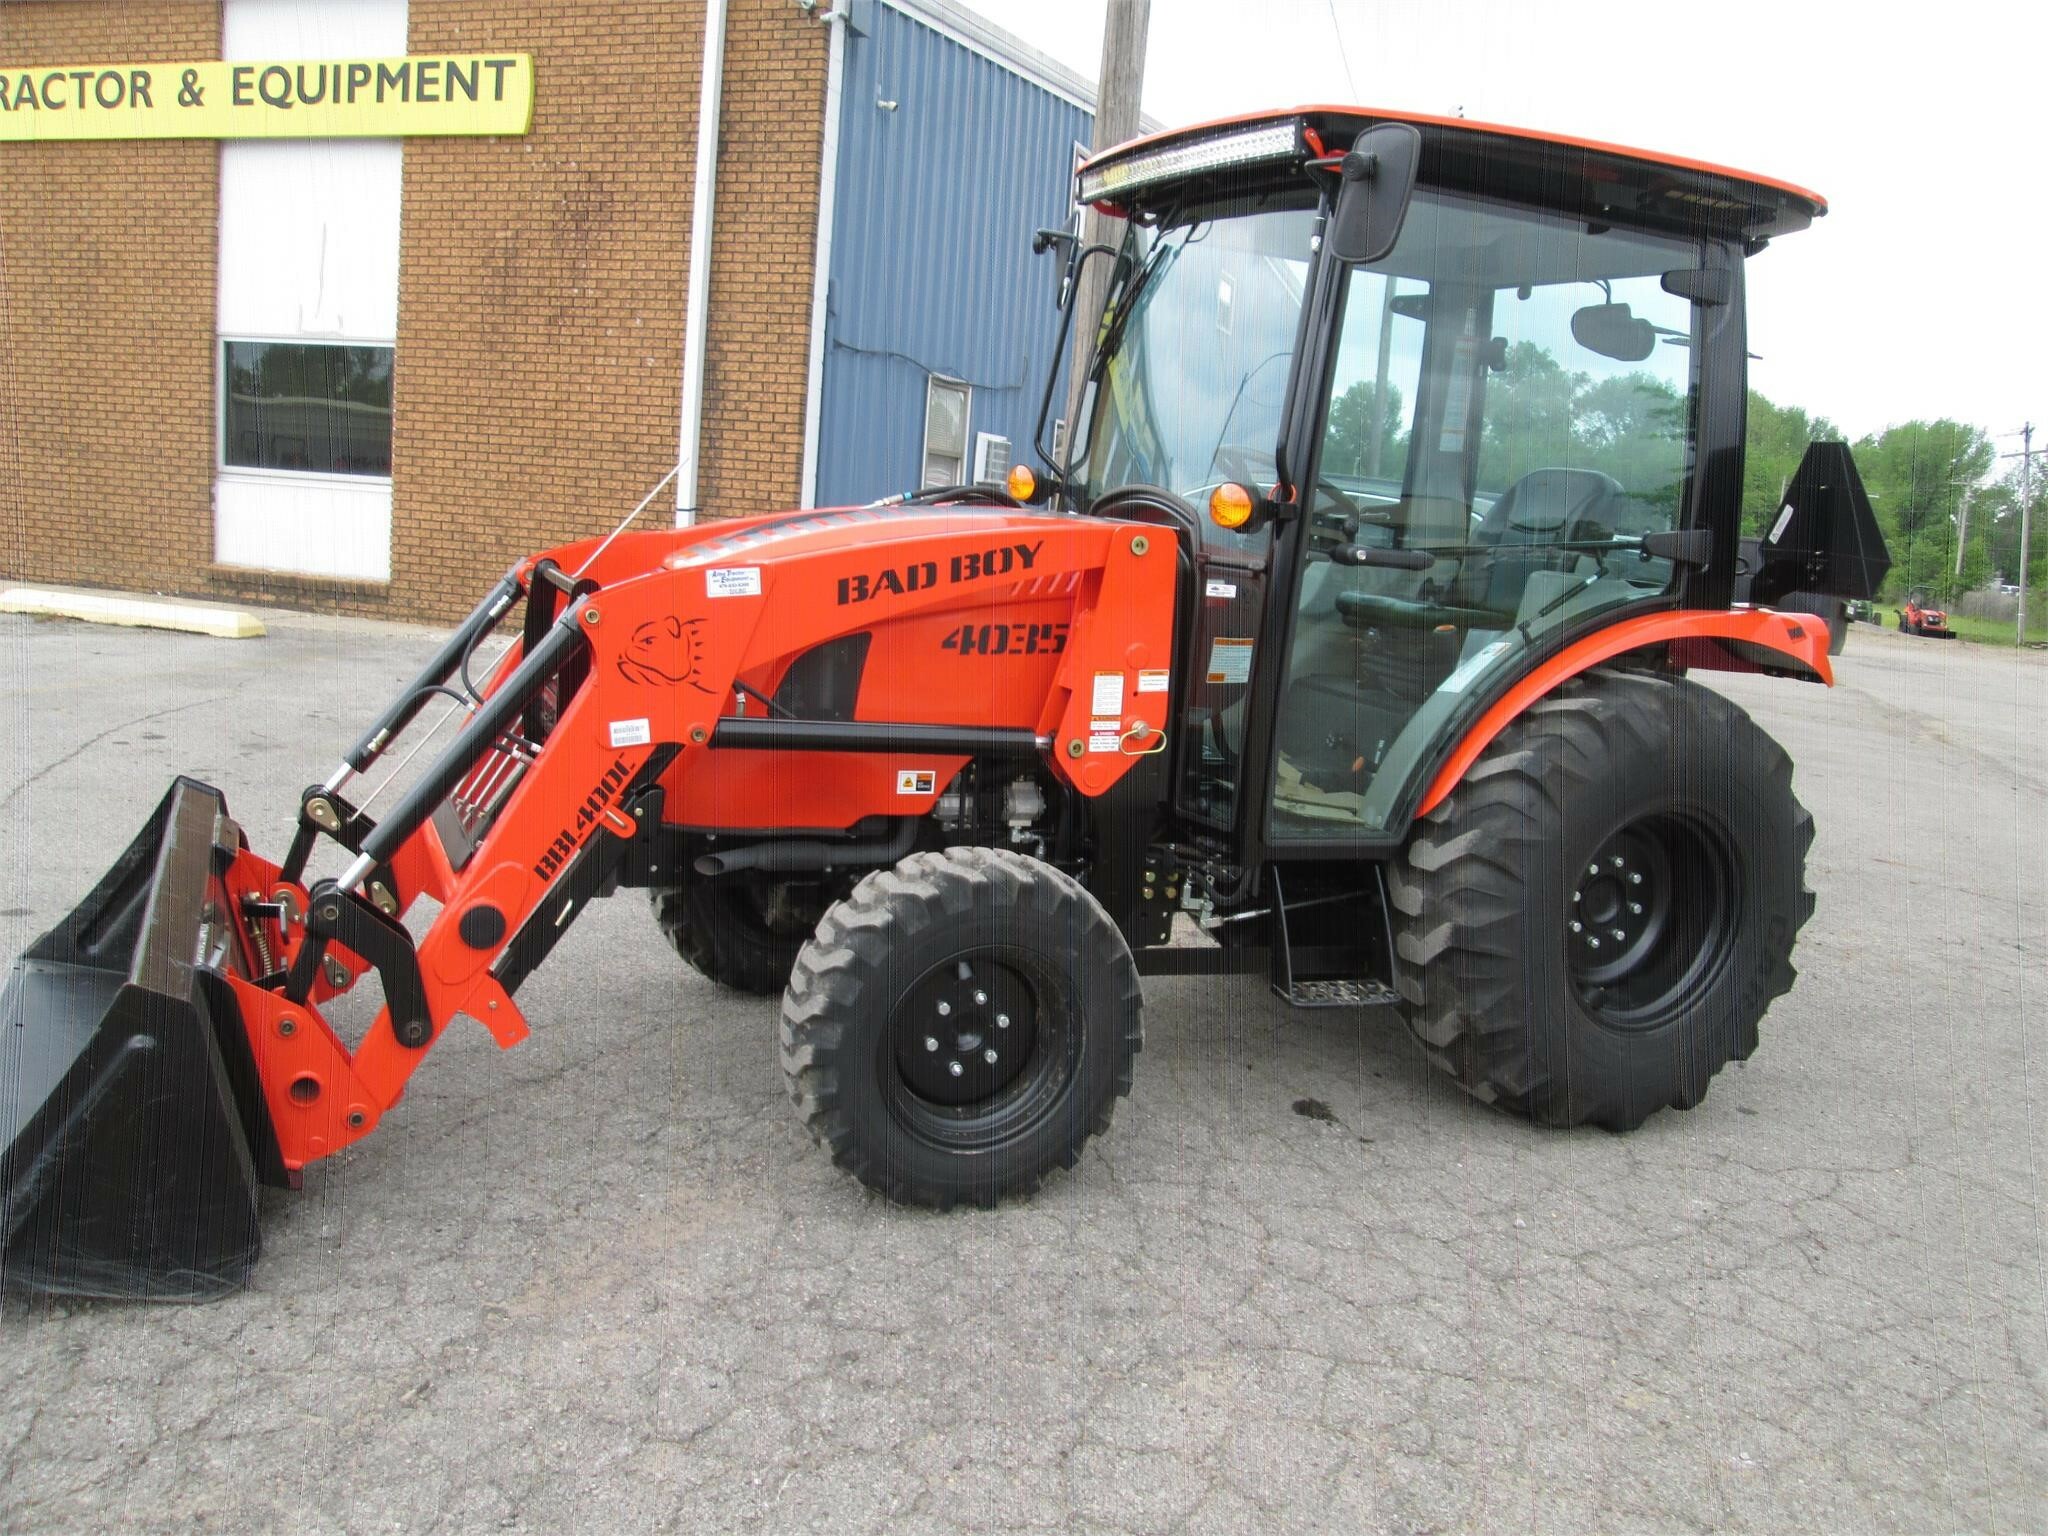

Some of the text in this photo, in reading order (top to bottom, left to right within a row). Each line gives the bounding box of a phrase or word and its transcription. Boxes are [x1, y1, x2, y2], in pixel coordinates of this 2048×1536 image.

[178, 69, 205, 107] &
[233, 60, 516, 109] EQUIPMENT
[837, 540, 1044, 606] BAD BOY
[941, 623, 1070, 656] 4035
